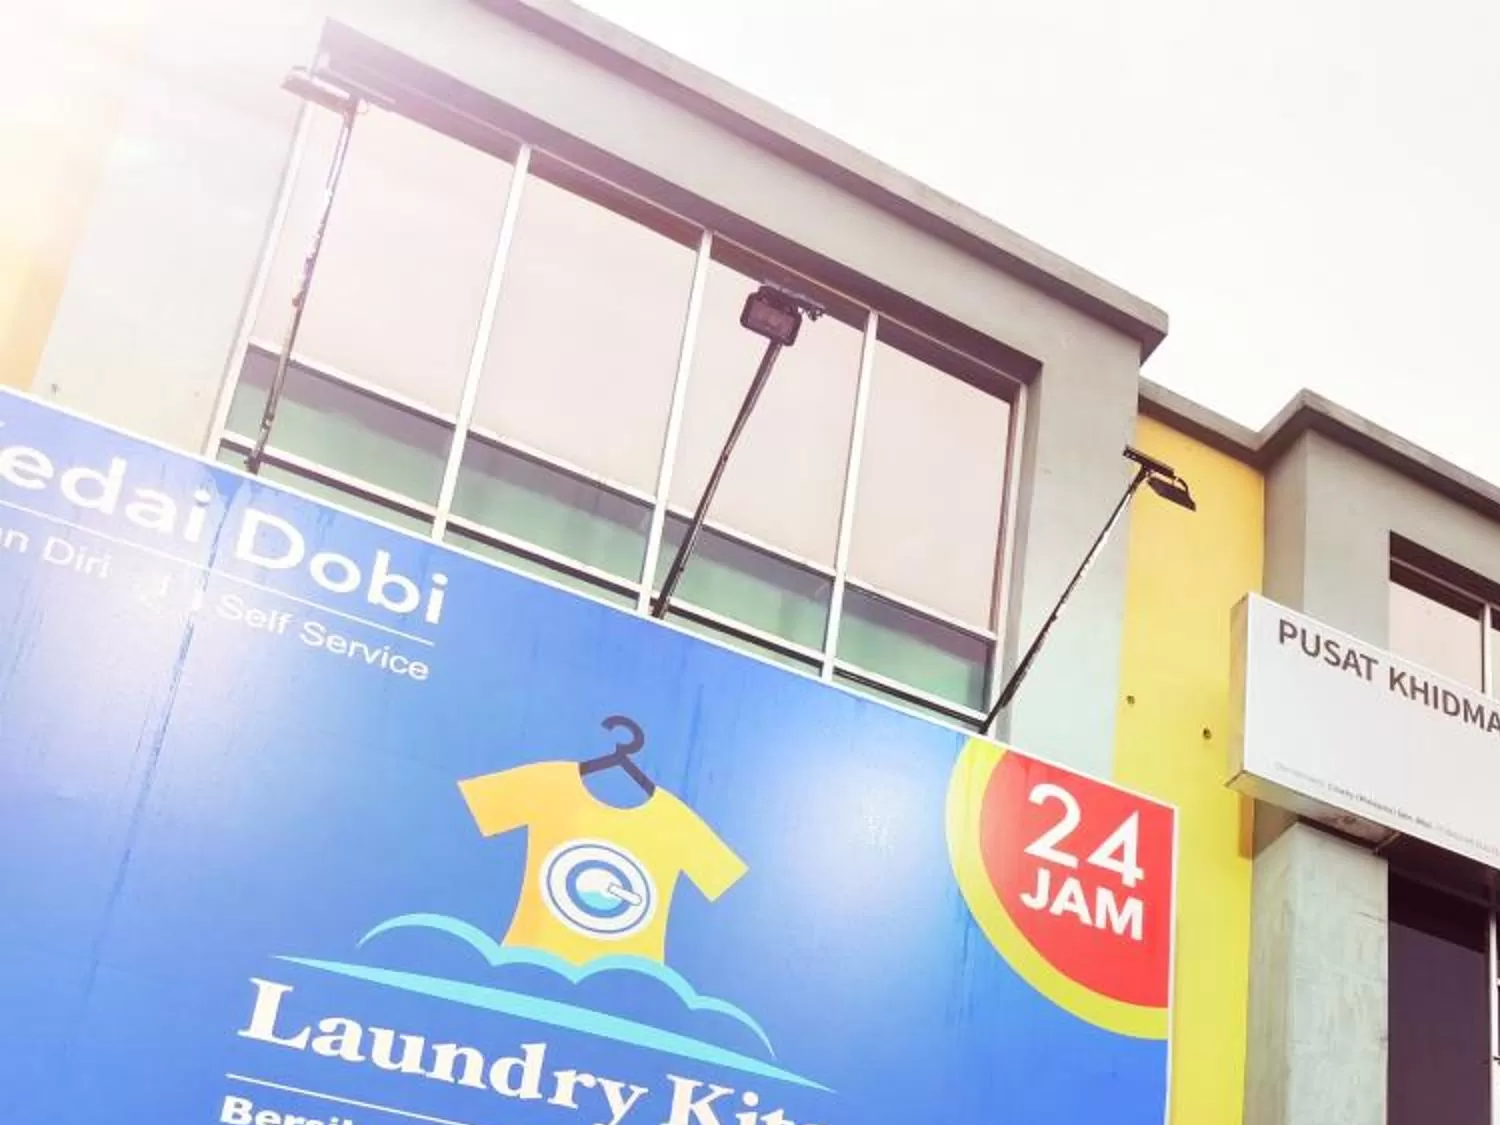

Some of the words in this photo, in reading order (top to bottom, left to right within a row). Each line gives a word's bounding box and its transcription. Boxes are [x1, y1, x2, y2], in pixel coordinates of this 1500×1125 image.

[0, 421, 212, 543] edai
[235, 507, 449, 625] Dobi
[43, 535, 113, 579] Diri
[215, 593, 294, 635] Self
[299, 621, 430, 682] Service
[1277, 618, 1380, 682] PUSAT
[1023, 782, 1145, 888] 24
[1019, 867, 1145, 942] JAM
